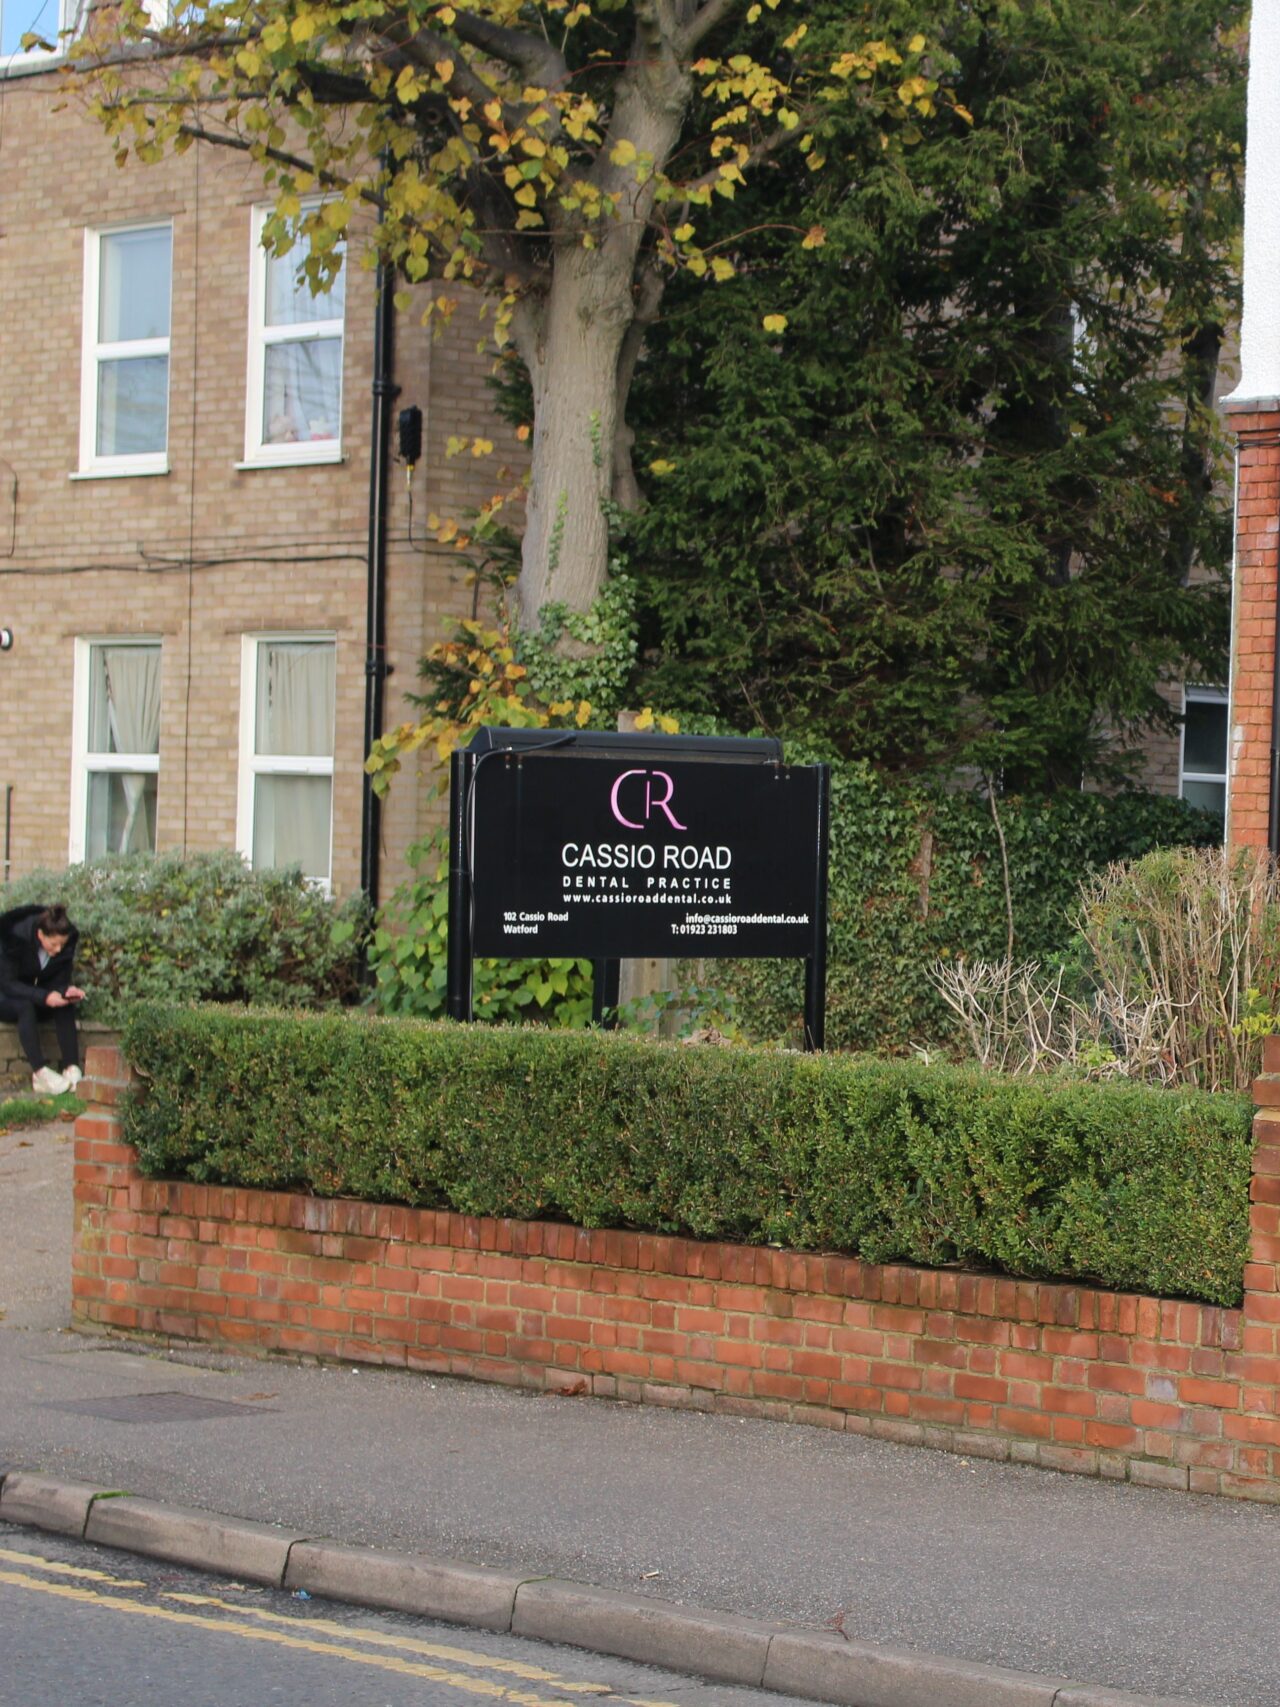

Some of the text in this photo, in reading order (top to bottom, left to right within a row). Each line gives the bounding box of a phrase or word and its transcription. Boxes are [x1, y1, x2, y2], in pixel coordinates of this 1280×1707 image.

[610, 769, 687, 830] CR
[562, 843, 732, 869] CASSIO ROAD
[562, 876, 731, 890] DENTAL PRACTICE
[563, 893, 732, 904] www.cassioroaddental.co.uk
[503, 912, 569, 922] 102 Cassio Road
[686, 913, 809, 924] info@cassioroaddental.co.uk
[504, 924, 538, 934] Watford
[680, 925, 706, 935] 01923
[707, 925, 738, 936] 231803
